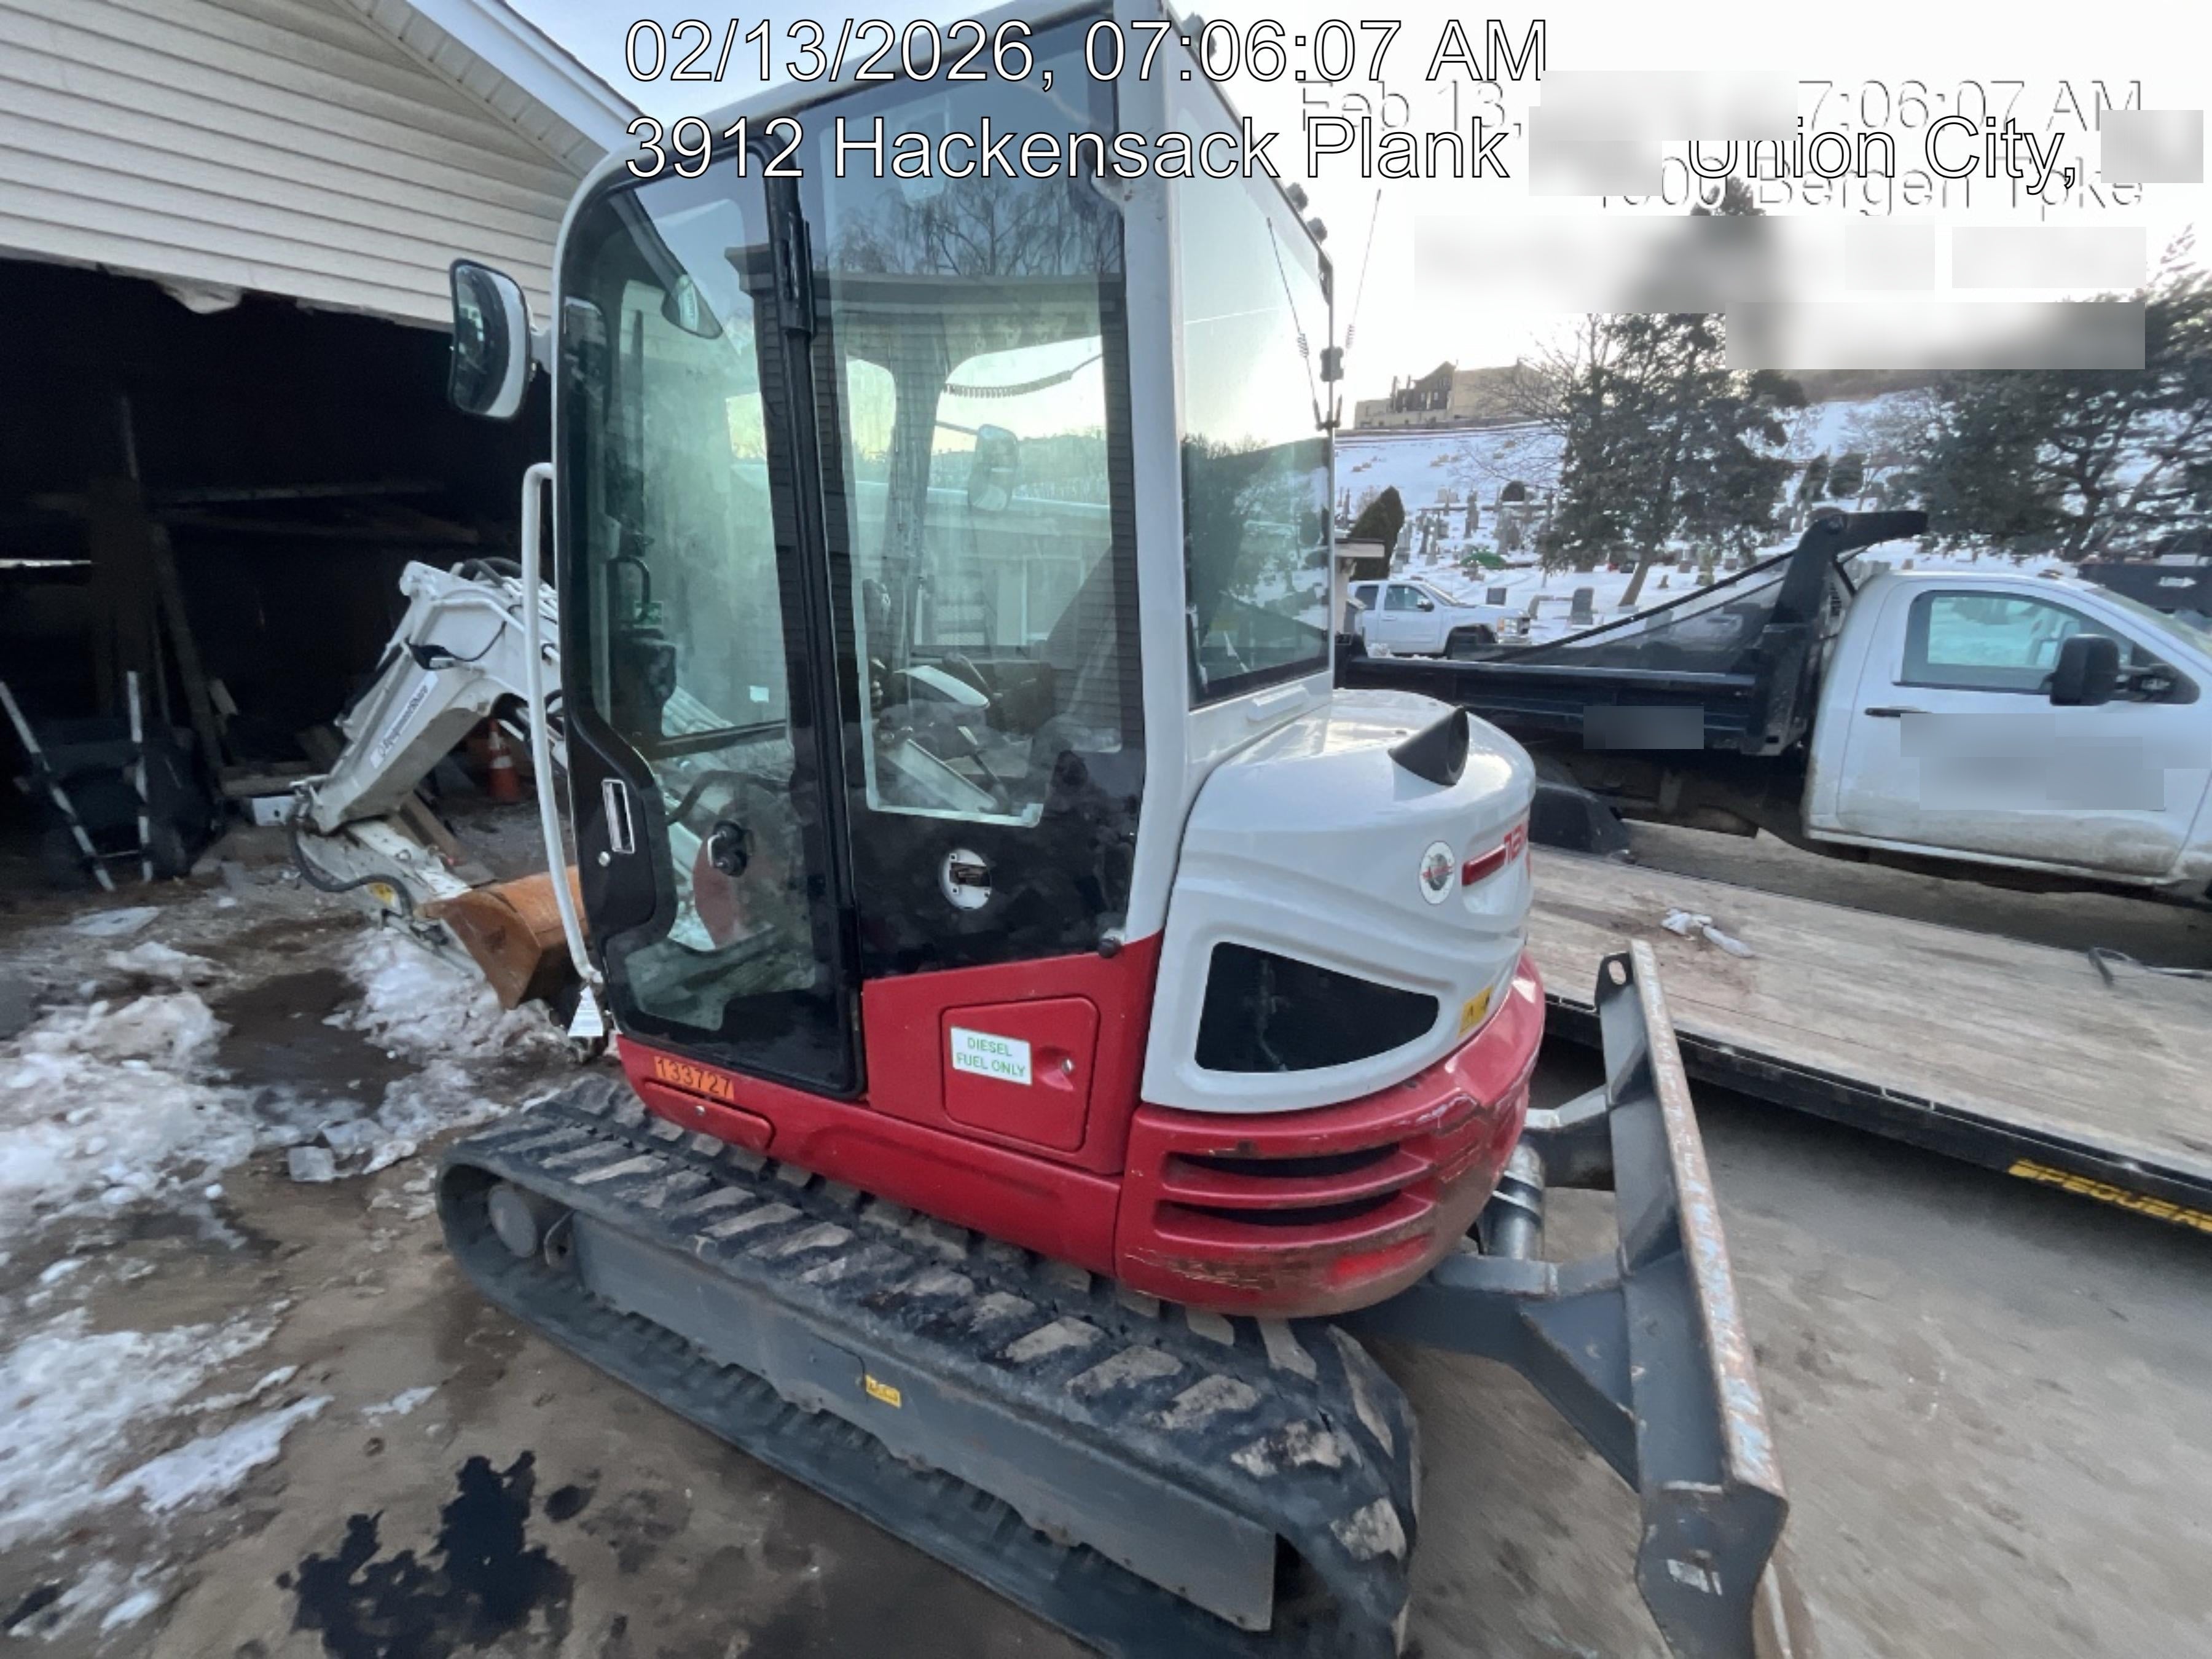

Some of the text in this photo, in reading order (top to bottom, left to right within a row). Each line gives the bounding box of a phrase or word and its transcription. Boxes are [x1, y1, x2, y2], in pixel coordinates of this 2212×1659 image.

[967, 1037, 1013, 1057] DIESEL
[657, 1058, 731, 1097] 133727
[955, 1052, 1026, 1078] FUEL ONLY
